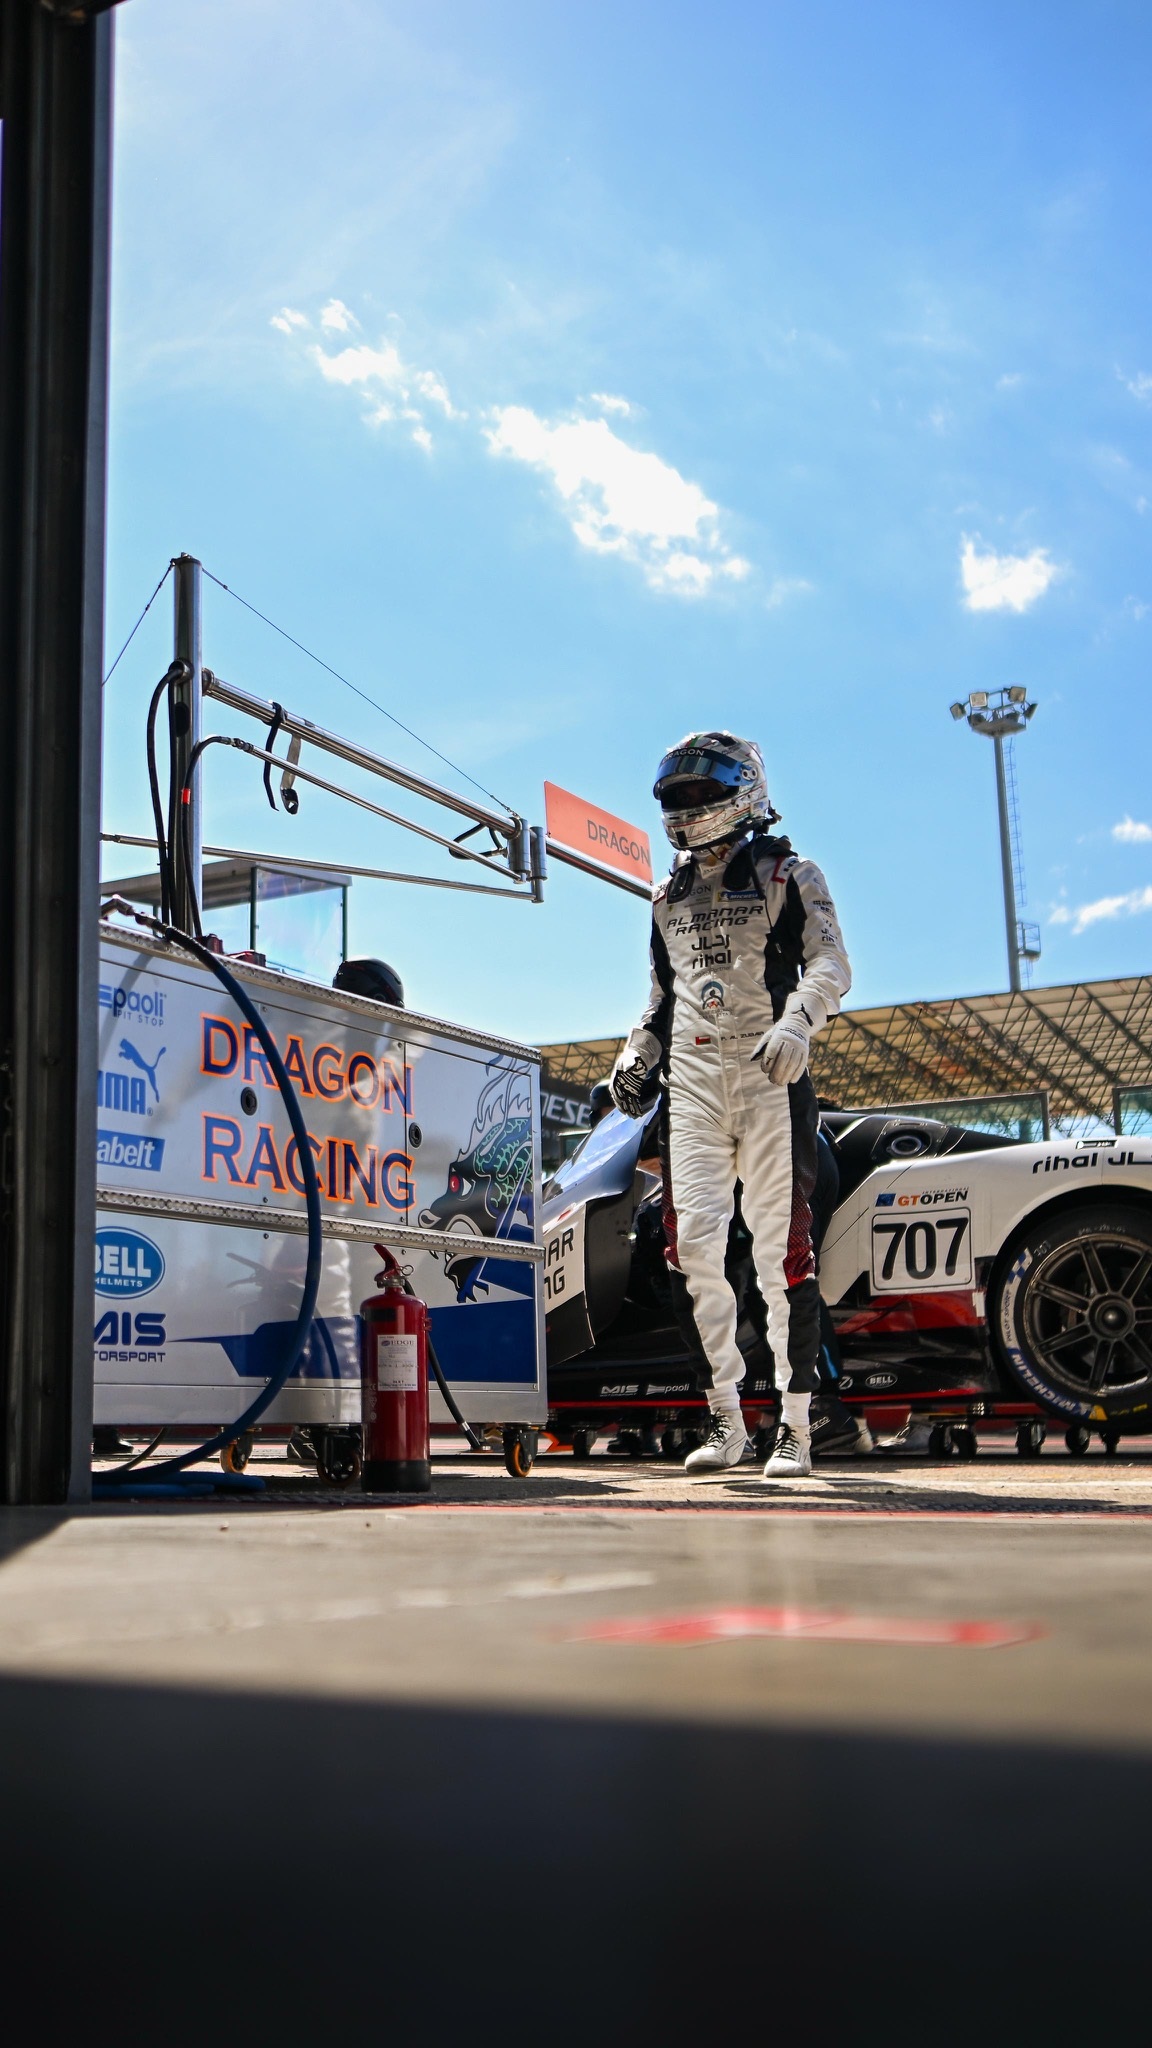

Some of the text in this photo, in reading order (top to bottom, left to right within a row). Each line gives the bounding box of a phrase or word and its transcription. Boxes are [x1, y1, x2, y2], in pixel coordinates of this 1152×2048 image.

[587, 819, 651, 868] DRAGON
[666, 905, 763, 929] ALMANAR
[675, 916, 749, 937] RACING
[692, 949, 732, 969] rihal
[113, 987, 164, 1017] paoli
[117, 1009, 164, 1027] PIT STOP
[201, 1012, 414, 1117] DRAGON
[97, 1070, 146, 1115] MA
[97, 1136, 156, 1168] abelt
[202, 1111, 417, 1213] RACING
[1032, 1152, 1098, 1174] rihal
[873, 1217, 969, 1280] 707
[601, 1384, 639, 1394] MIS
[664, 1384, 690, 1394] paoli
[869, 1376, 893, 1385] BELL
[1010, 1353, 1077, 1412] MICHELIN
